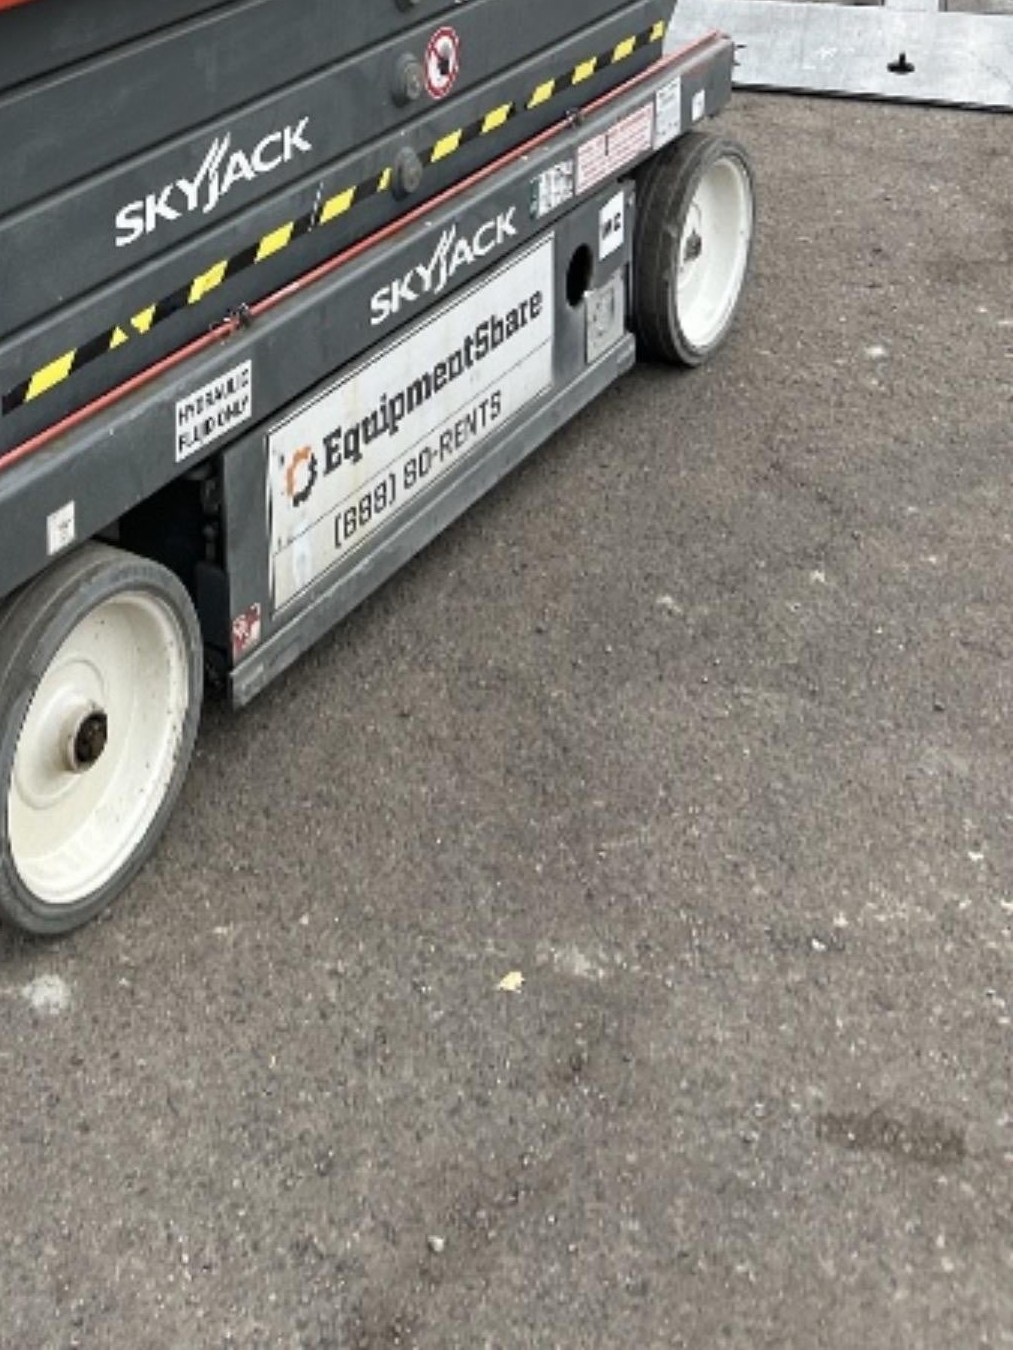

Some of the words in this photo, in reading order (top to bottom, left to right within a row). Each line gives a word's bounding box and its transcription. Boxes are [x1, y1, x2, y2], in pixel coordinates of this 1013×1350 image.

[115, 116, 312, 246] SKYJACK
[370, 206, 517, 325] SKYJACK
[322, 290, 543, 476] EquipmentShare
[334, 473, 397, 549] (888)
[403, 390, 502, 489] 80-RENTS
